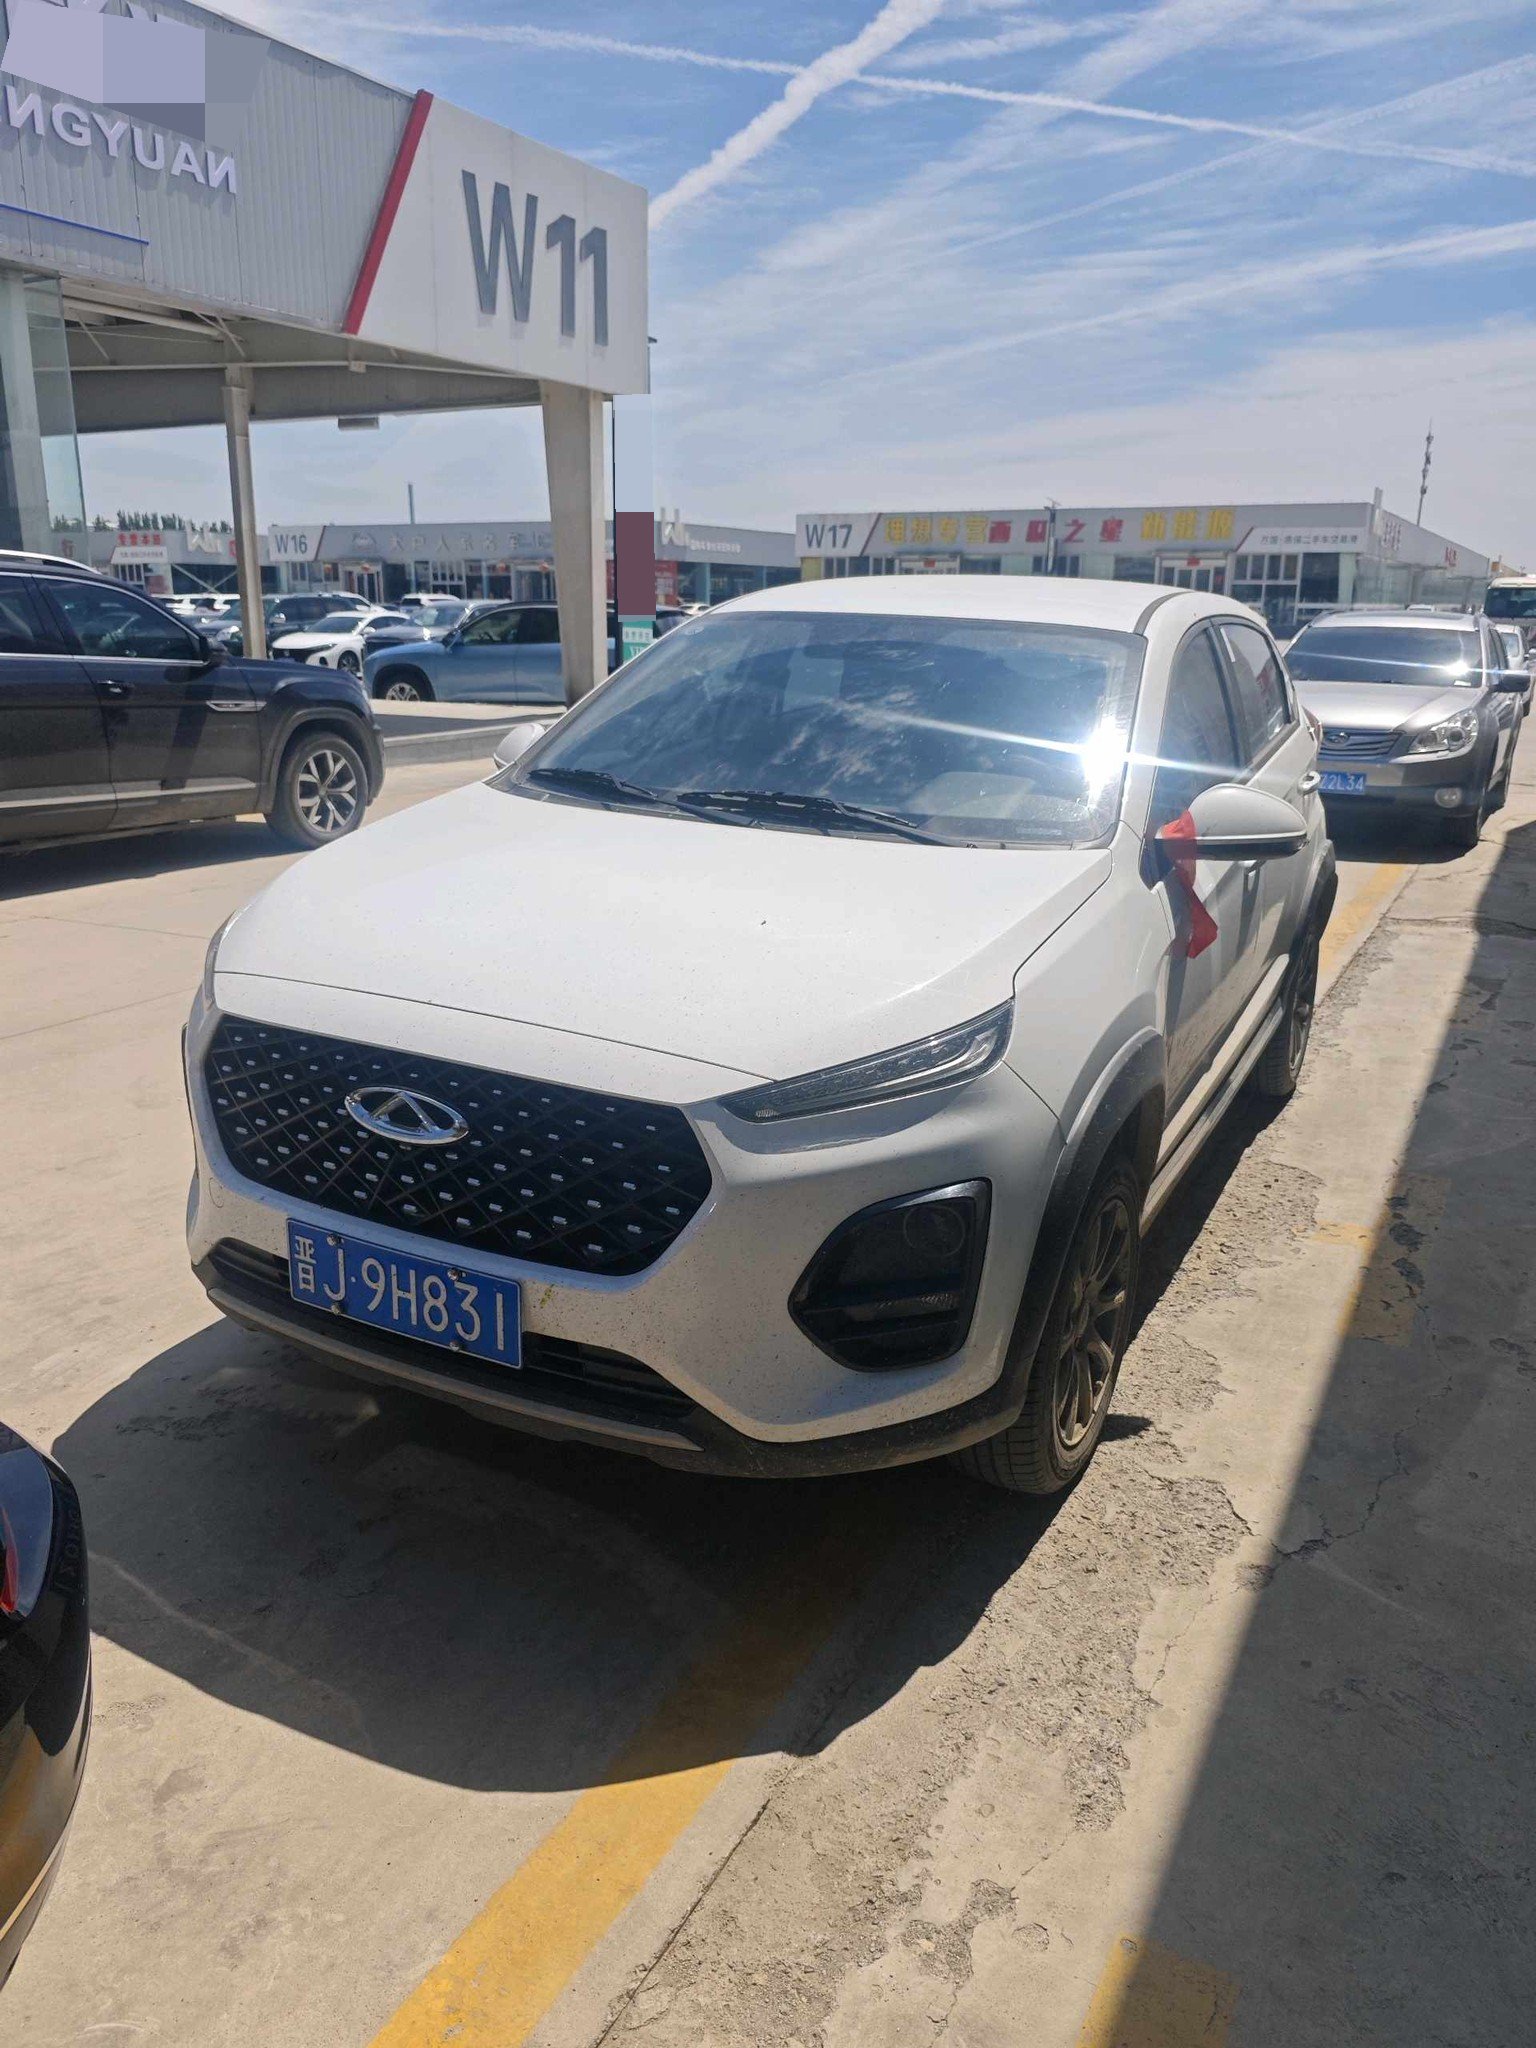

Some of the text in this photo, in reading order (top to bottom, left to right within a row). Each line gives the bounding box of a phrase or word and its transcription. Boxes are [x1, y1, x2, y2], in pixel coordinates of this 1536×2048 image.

[1, 84, 237, 195] NGYUAN
[461, 169, 608, 347] W11
[275, 534, 308, 554] W16
[805, 523, 853, 549] W17
